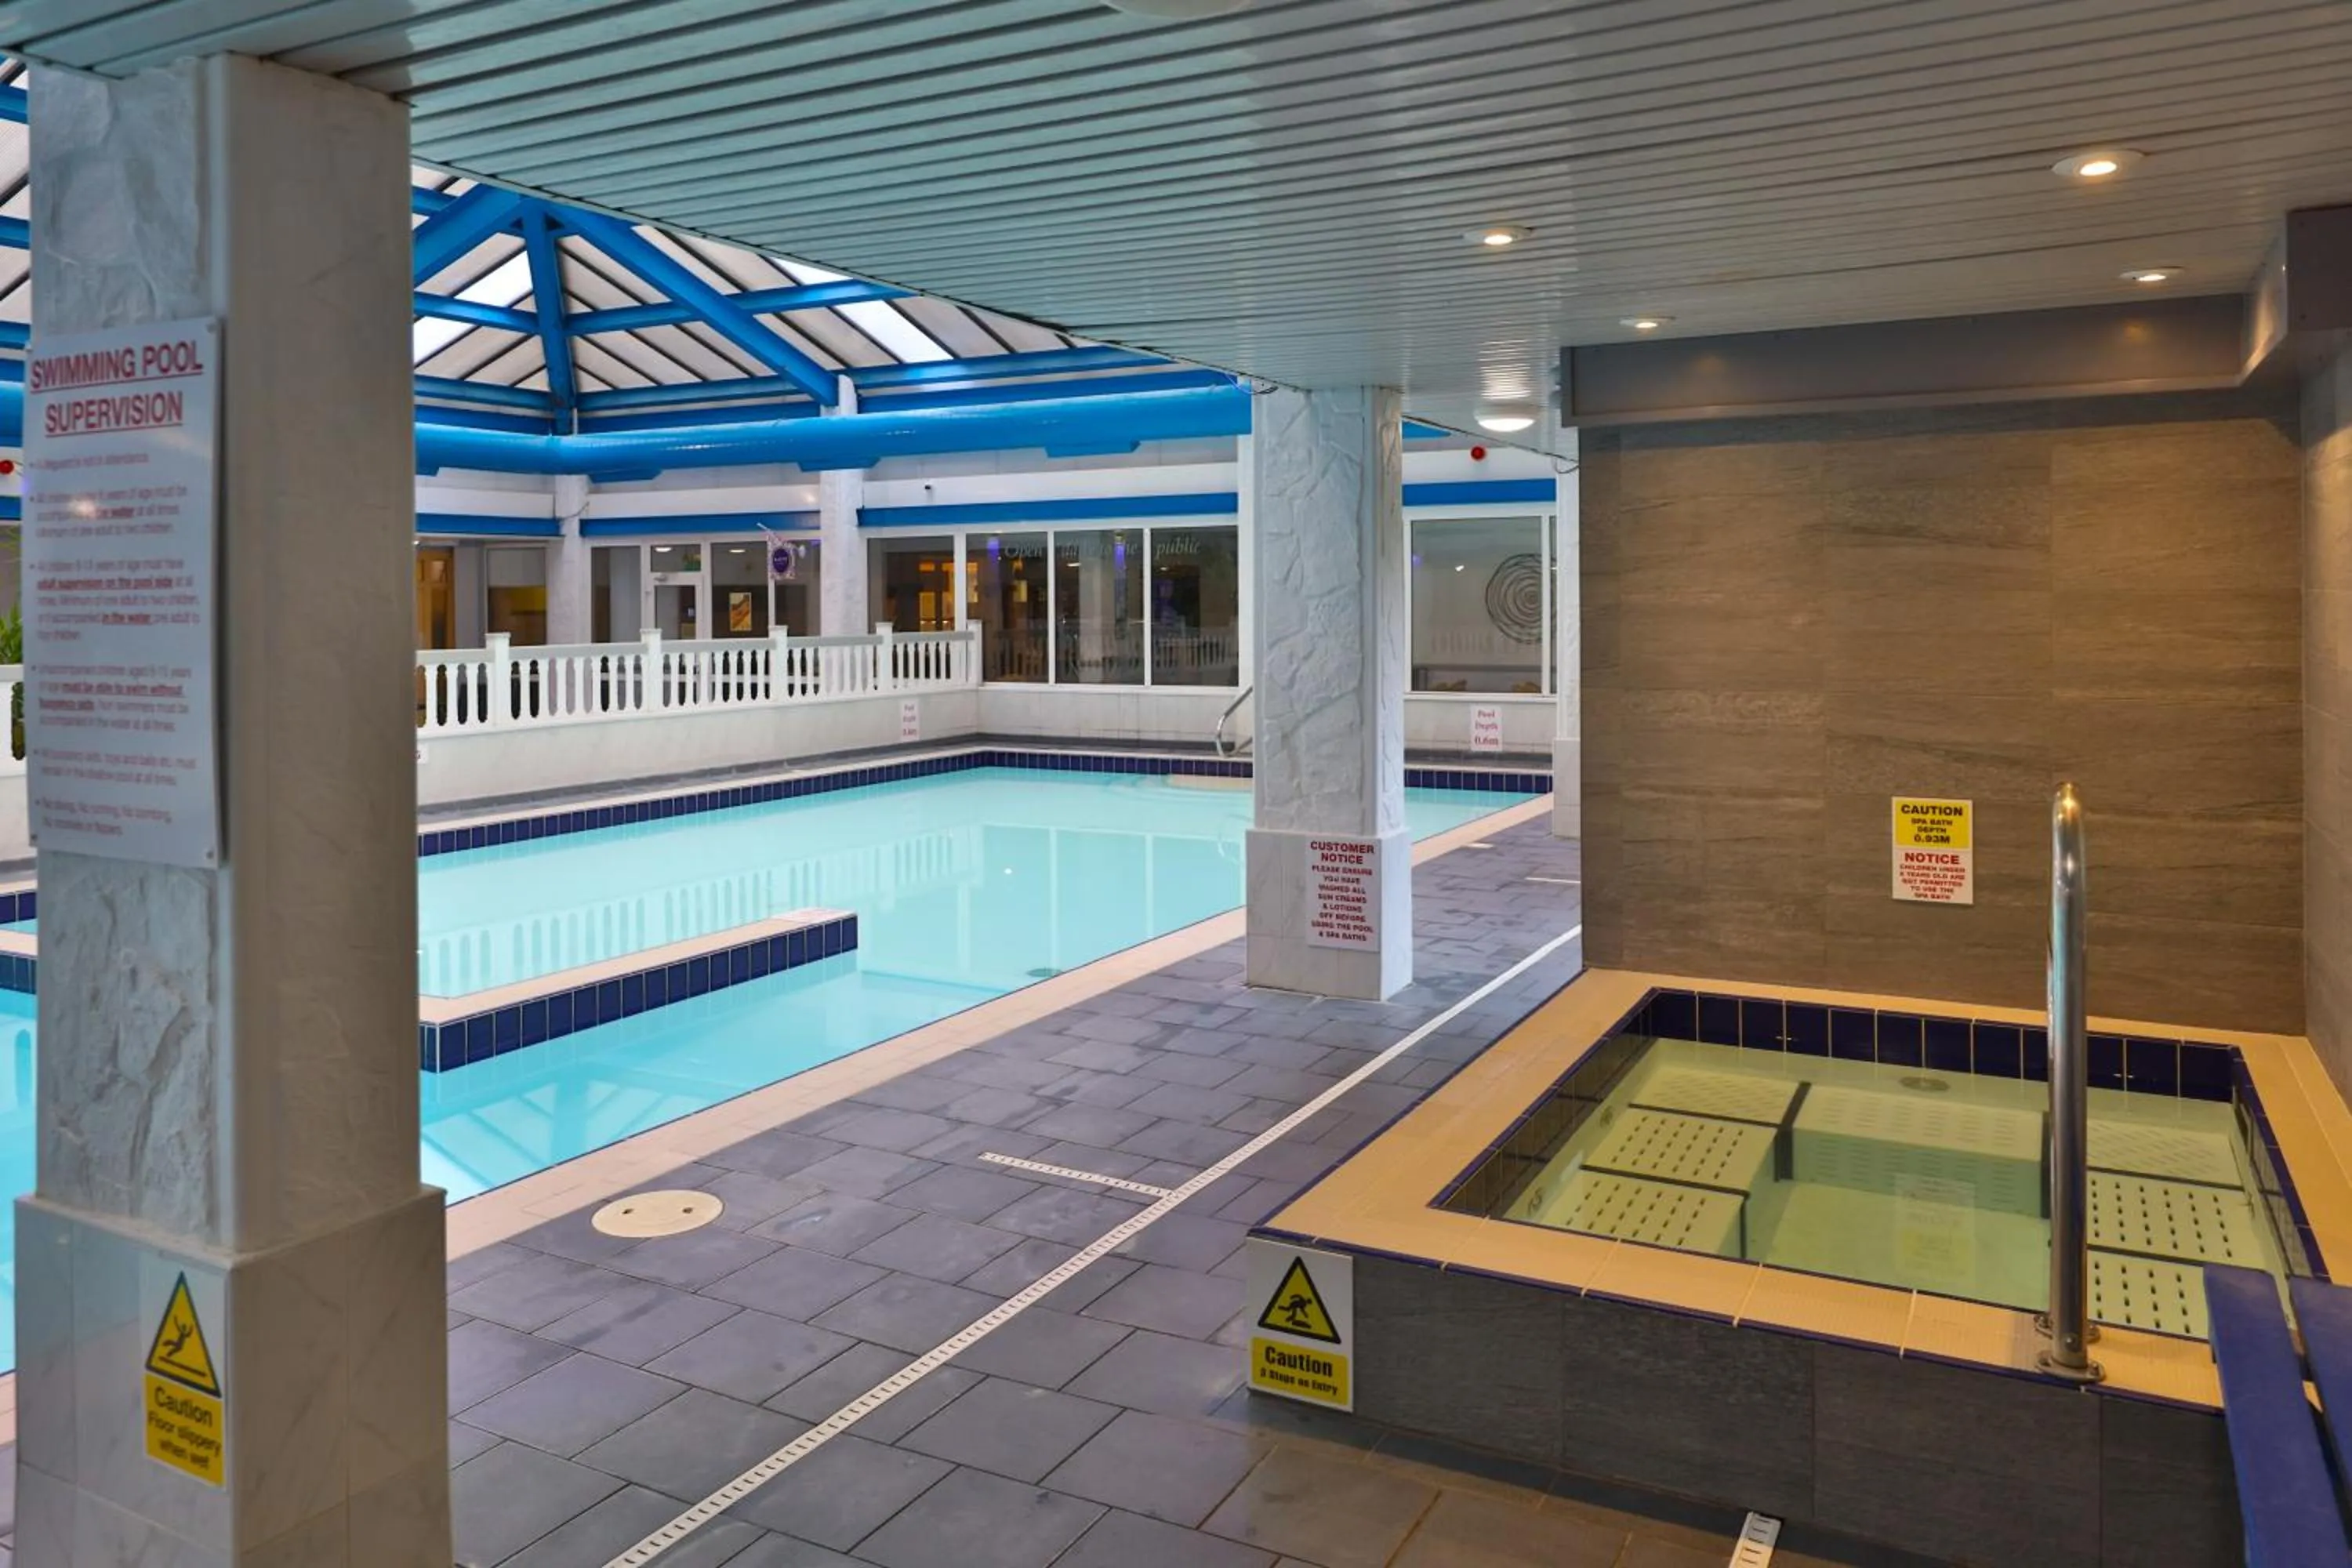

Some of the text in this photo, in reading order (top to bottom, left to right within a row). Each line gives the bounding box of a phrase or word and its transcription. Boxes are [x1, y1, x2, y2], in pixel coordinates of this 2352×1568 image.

[31, 339, 204, 390] SWIMMING POOL
[45, 390, 183, 433] SUPERVISION
[1156, 535, 1201, 561] public
[1901, 804, 1963, 816] CAUTION
[1914, 834, 1951, 844] 0.93M
[1310, 840, 1374, 854] CUSTOMER
[1321, 853, 1363, 864] NOTICE
[1905, 852, 1960, 865] NOTICE
[1342, 866, 1373, 876] ENSURE
[1318, 884, 1350, 893] WASHED
[1335, 895, 1367, 904] CREAMS
[1330, 904, 1363, 913] LOTIONS
[1335, 913, 1366, 922] BEFORE
[1311, 920, 1334, 929] USING
[1353, 924, 1374, 933] POOL
[1342, 932, 1367, 942] BATHS
[1265, 1345, 1333, 1378] Caution
[1298, 1377, 1310, 1388] on
[1312, 1379, 1338, 1396] Entry
[154, 1386, 212, 1428] Caution
[147, 1410, 222, 1457] Floor slippery
